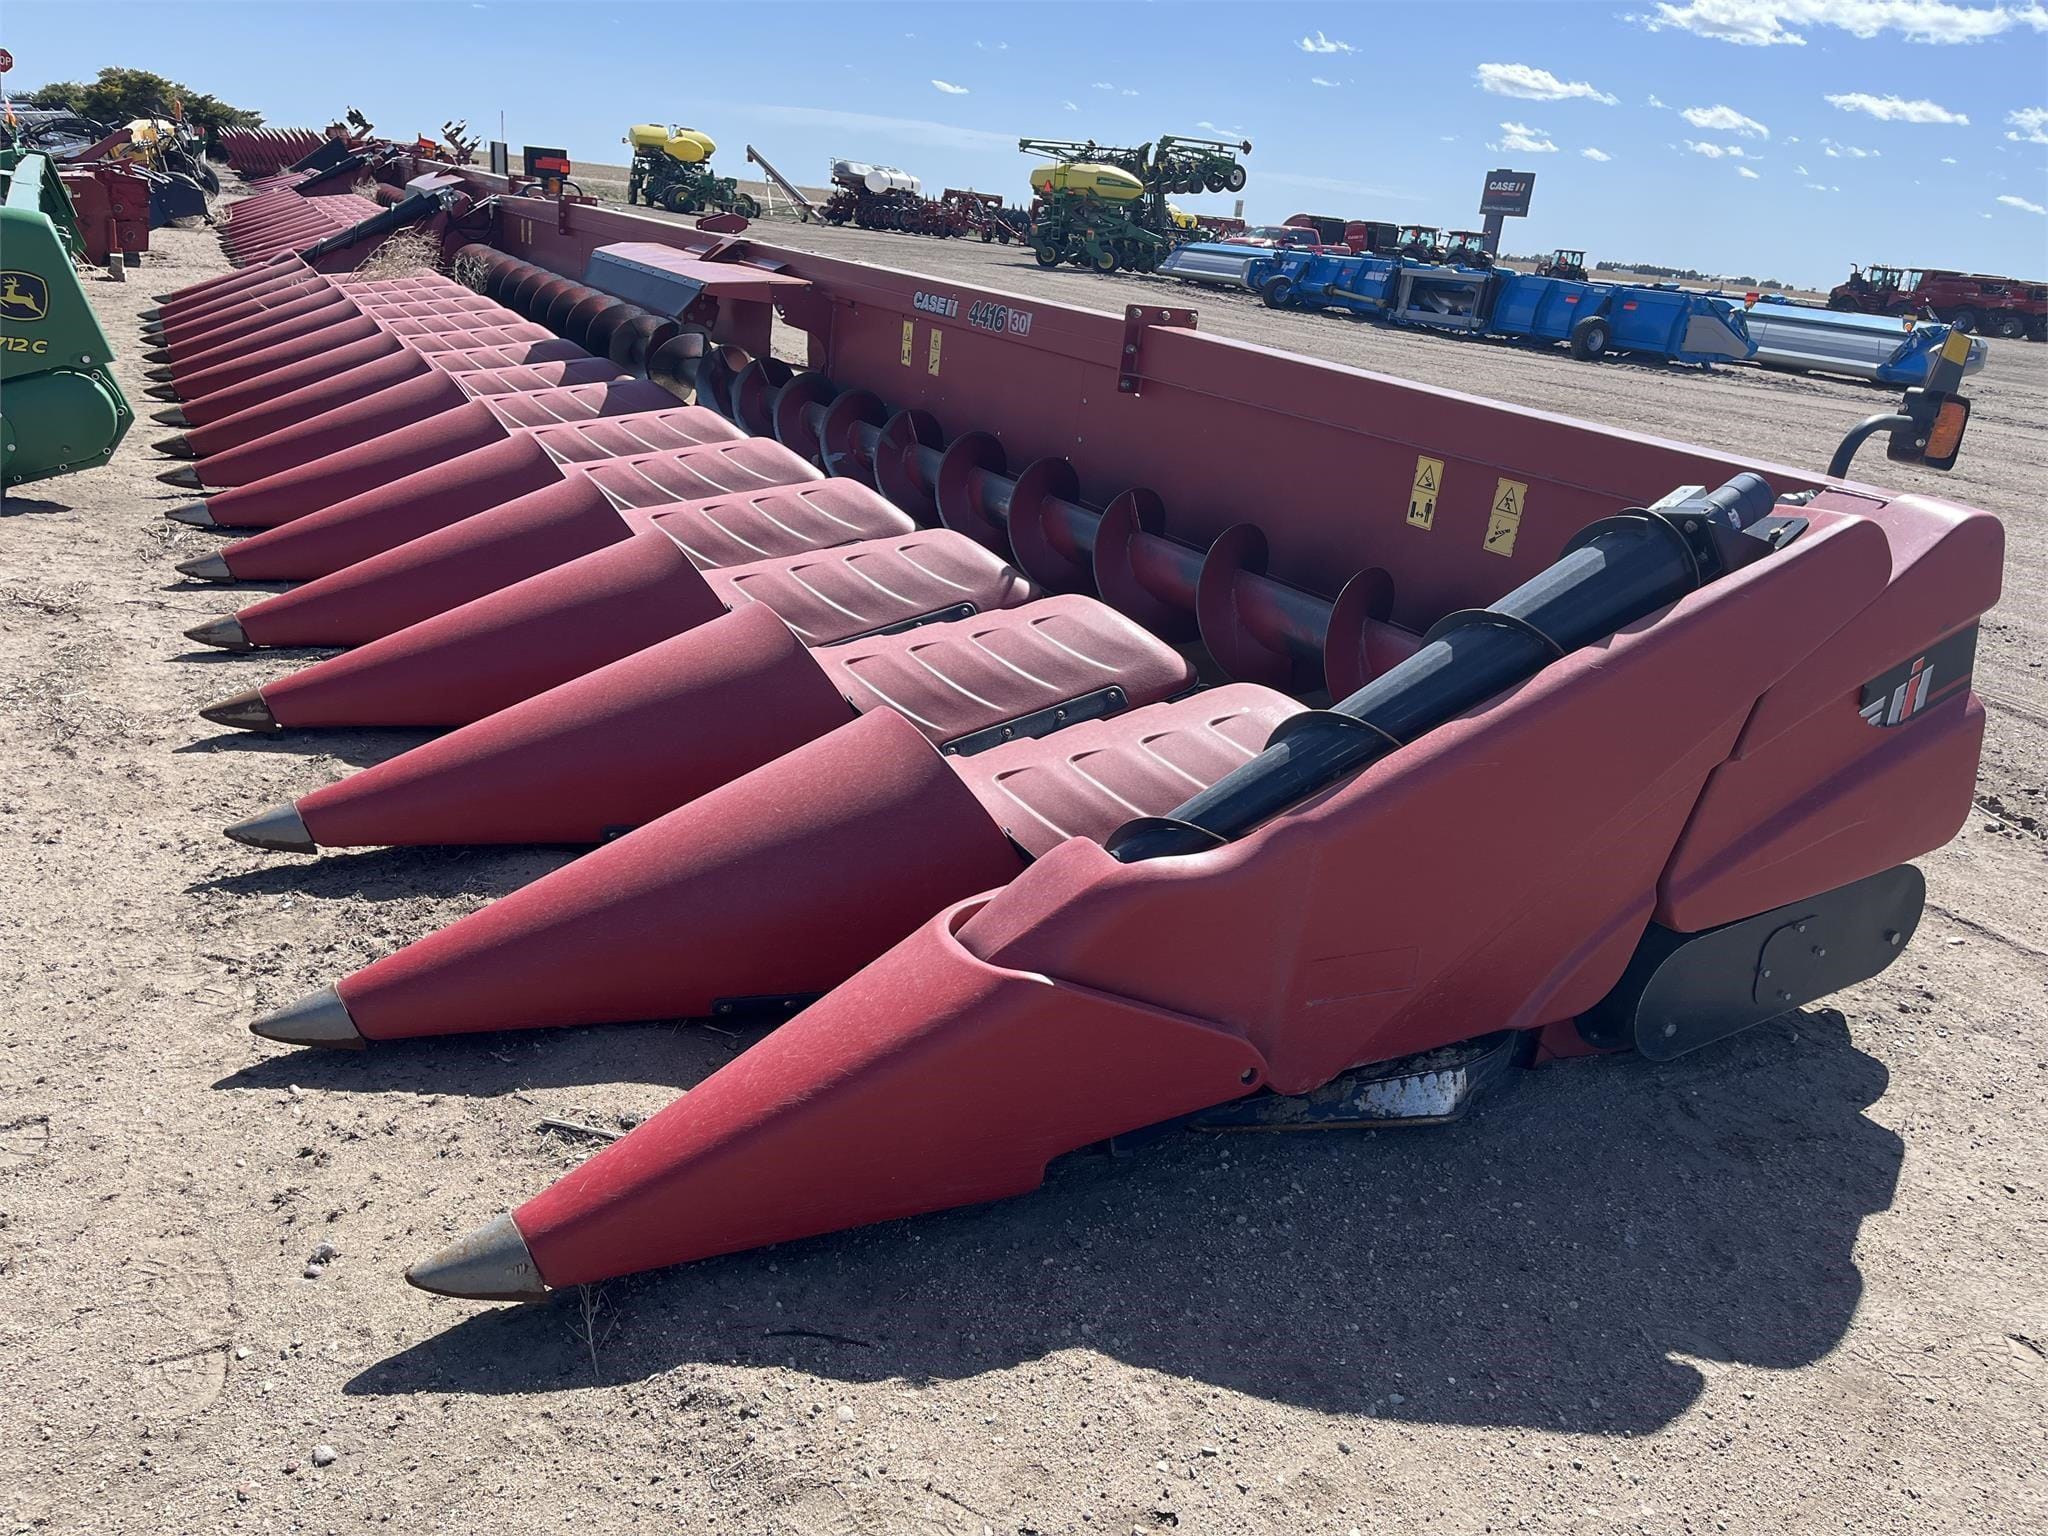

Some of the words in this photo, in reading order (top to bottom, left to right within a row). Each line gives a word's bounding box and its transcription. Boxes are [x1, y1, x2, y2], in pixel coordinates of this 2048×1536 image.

[0, 56, 11, 65] OP
[1489, 181, 1515, 191] CASE
[913, 291, 946, 315] CASE
[968, 300, 1007, 333] 4416
[1011, 312, 1027, 333] 30
